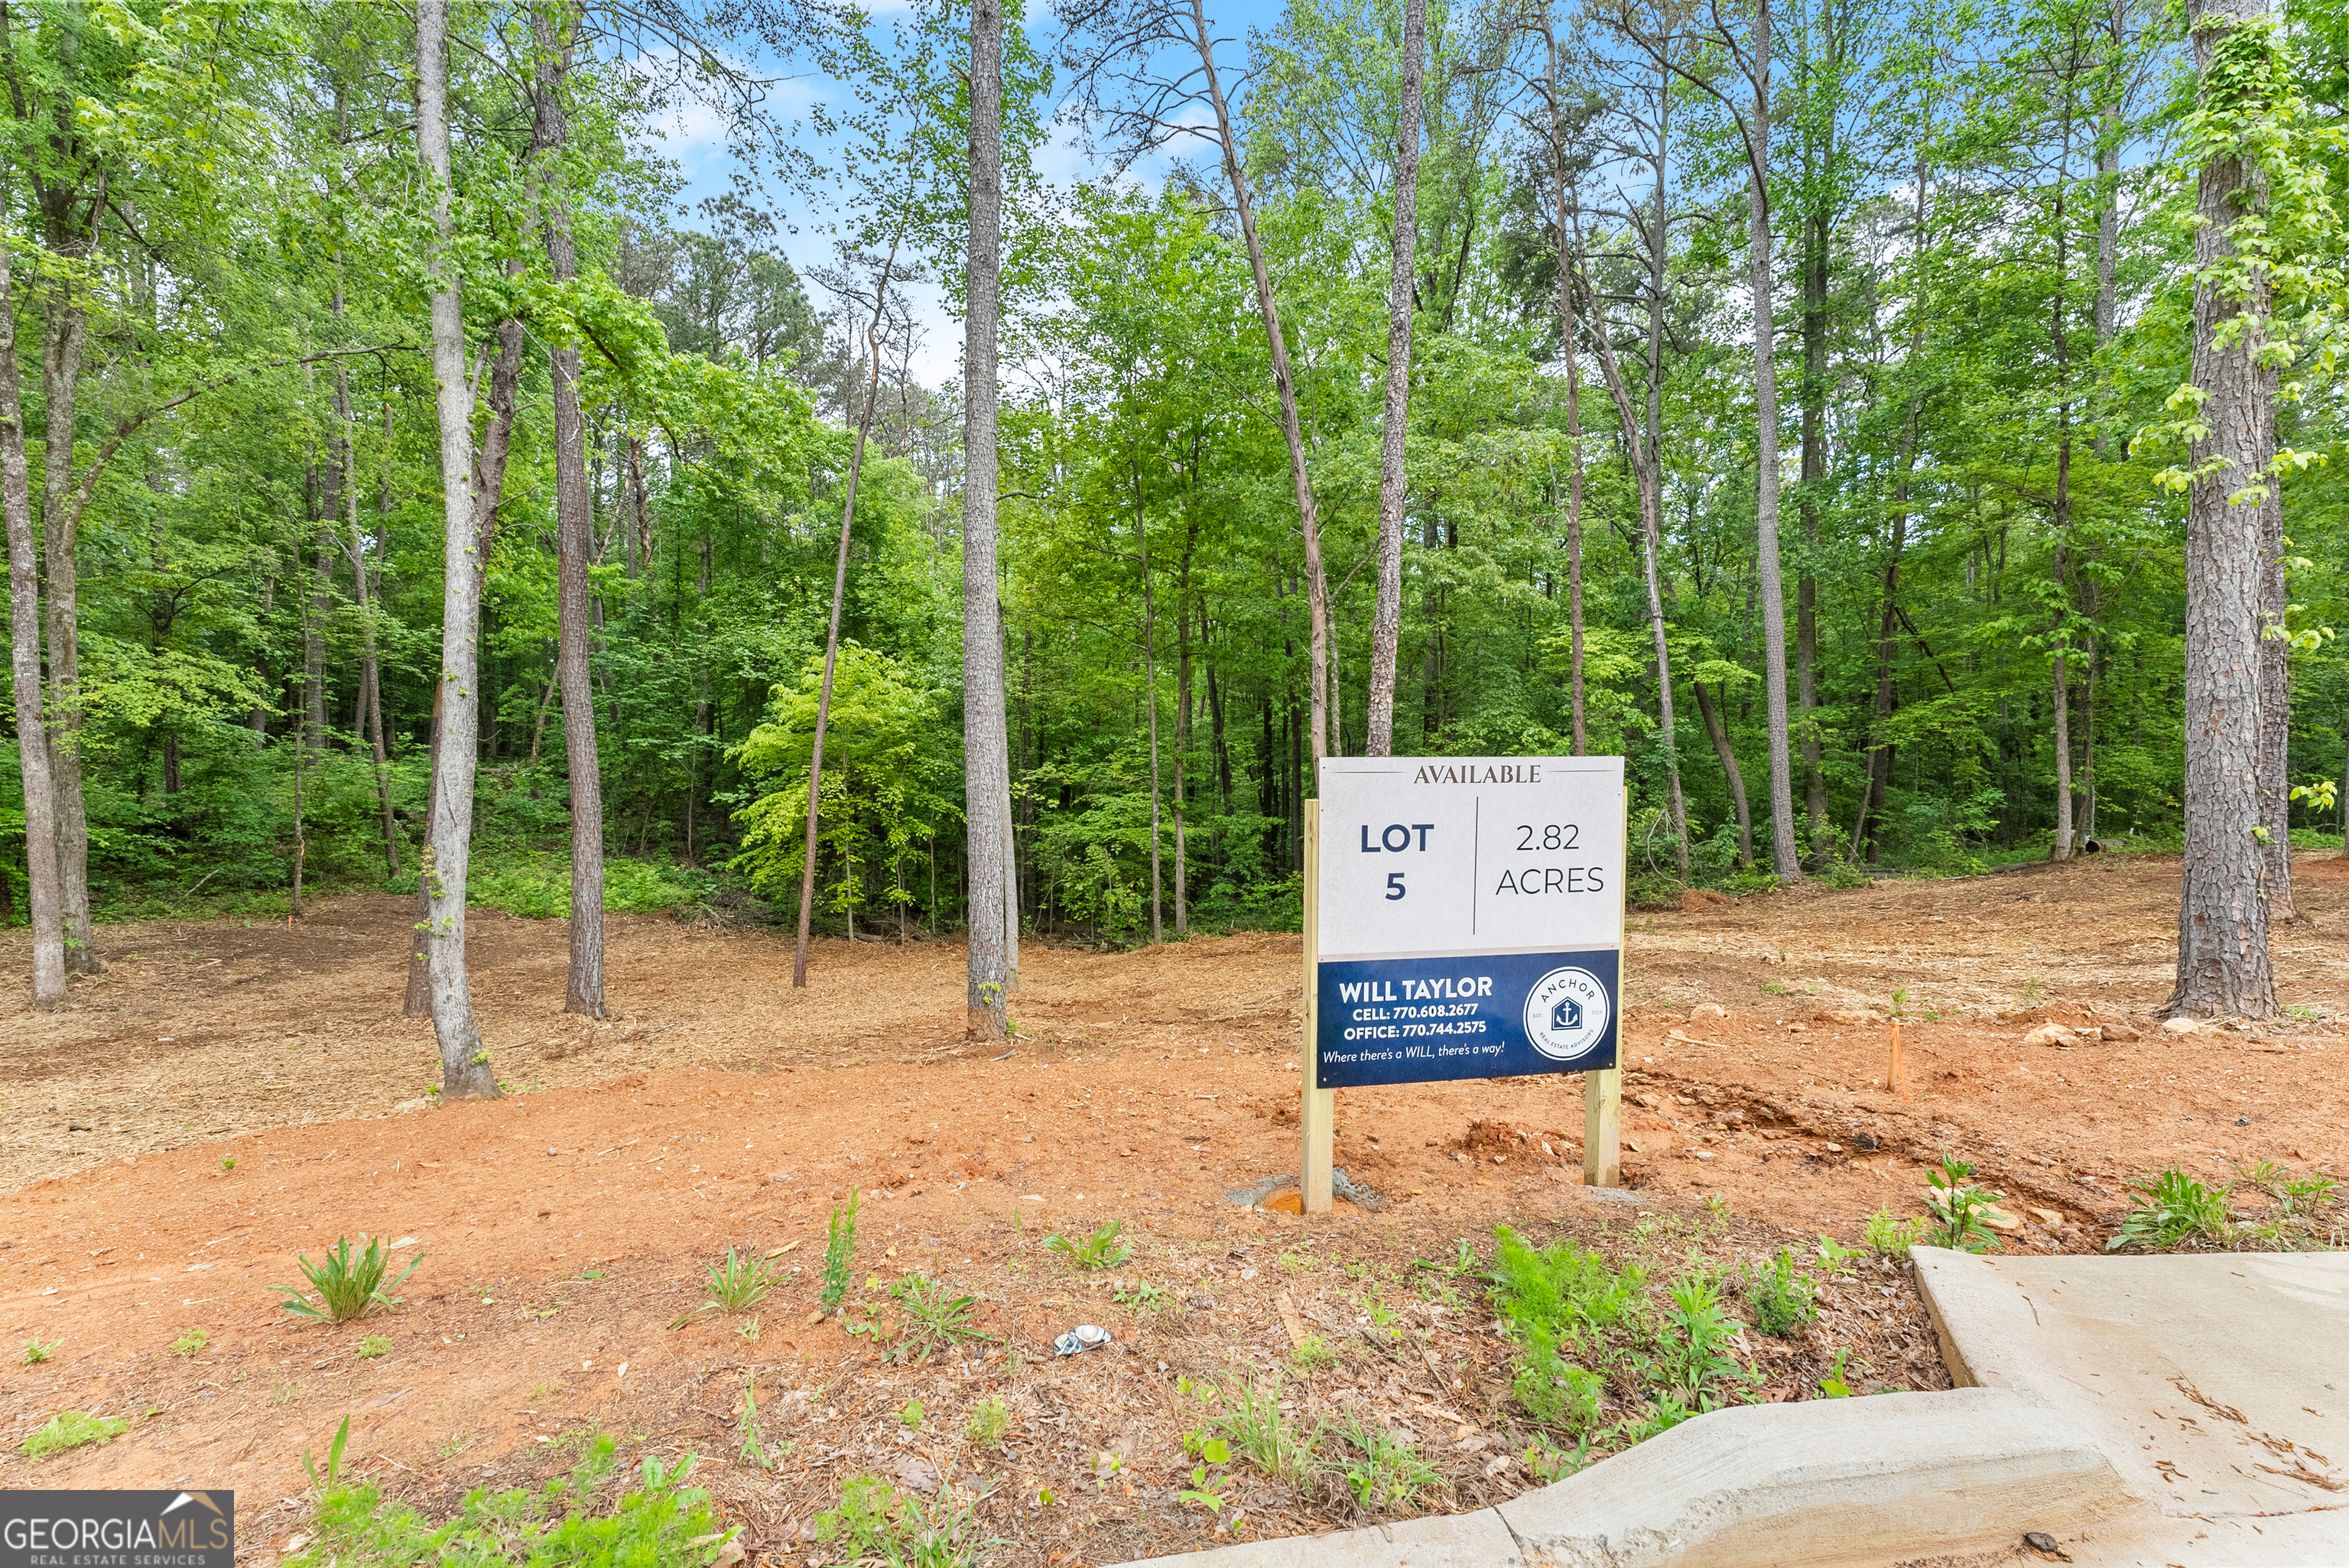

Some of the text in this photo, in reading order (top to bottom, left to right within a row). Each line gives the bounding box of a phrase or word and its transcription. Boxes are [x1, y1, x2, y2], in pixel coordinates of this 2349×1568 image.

[1413, 765, 1542, 784] AVAILABLE
[1361, 824, 1434, 853] LOT
[1516, 824, 1580, 851] 2.82
[1385, 872, 1406, 901] 5
[1496, 867, 1604, 895] ACRES
[1339, 976, 1493, 1004] WILL TAYLOR
[1541, 979, 1595, 1003] ANCHOR
[1353, 1003, 1479, 1021] CELL: 770.608.2677
[1343, 1021, 1486, 1040] OFFICE: 770.744.2575
[1539, 1029, 1594, 1050] REAL ESTATE ADVISORS
[1323, 1040, 1505, 1063] Where there's a WILL, there's a way!
